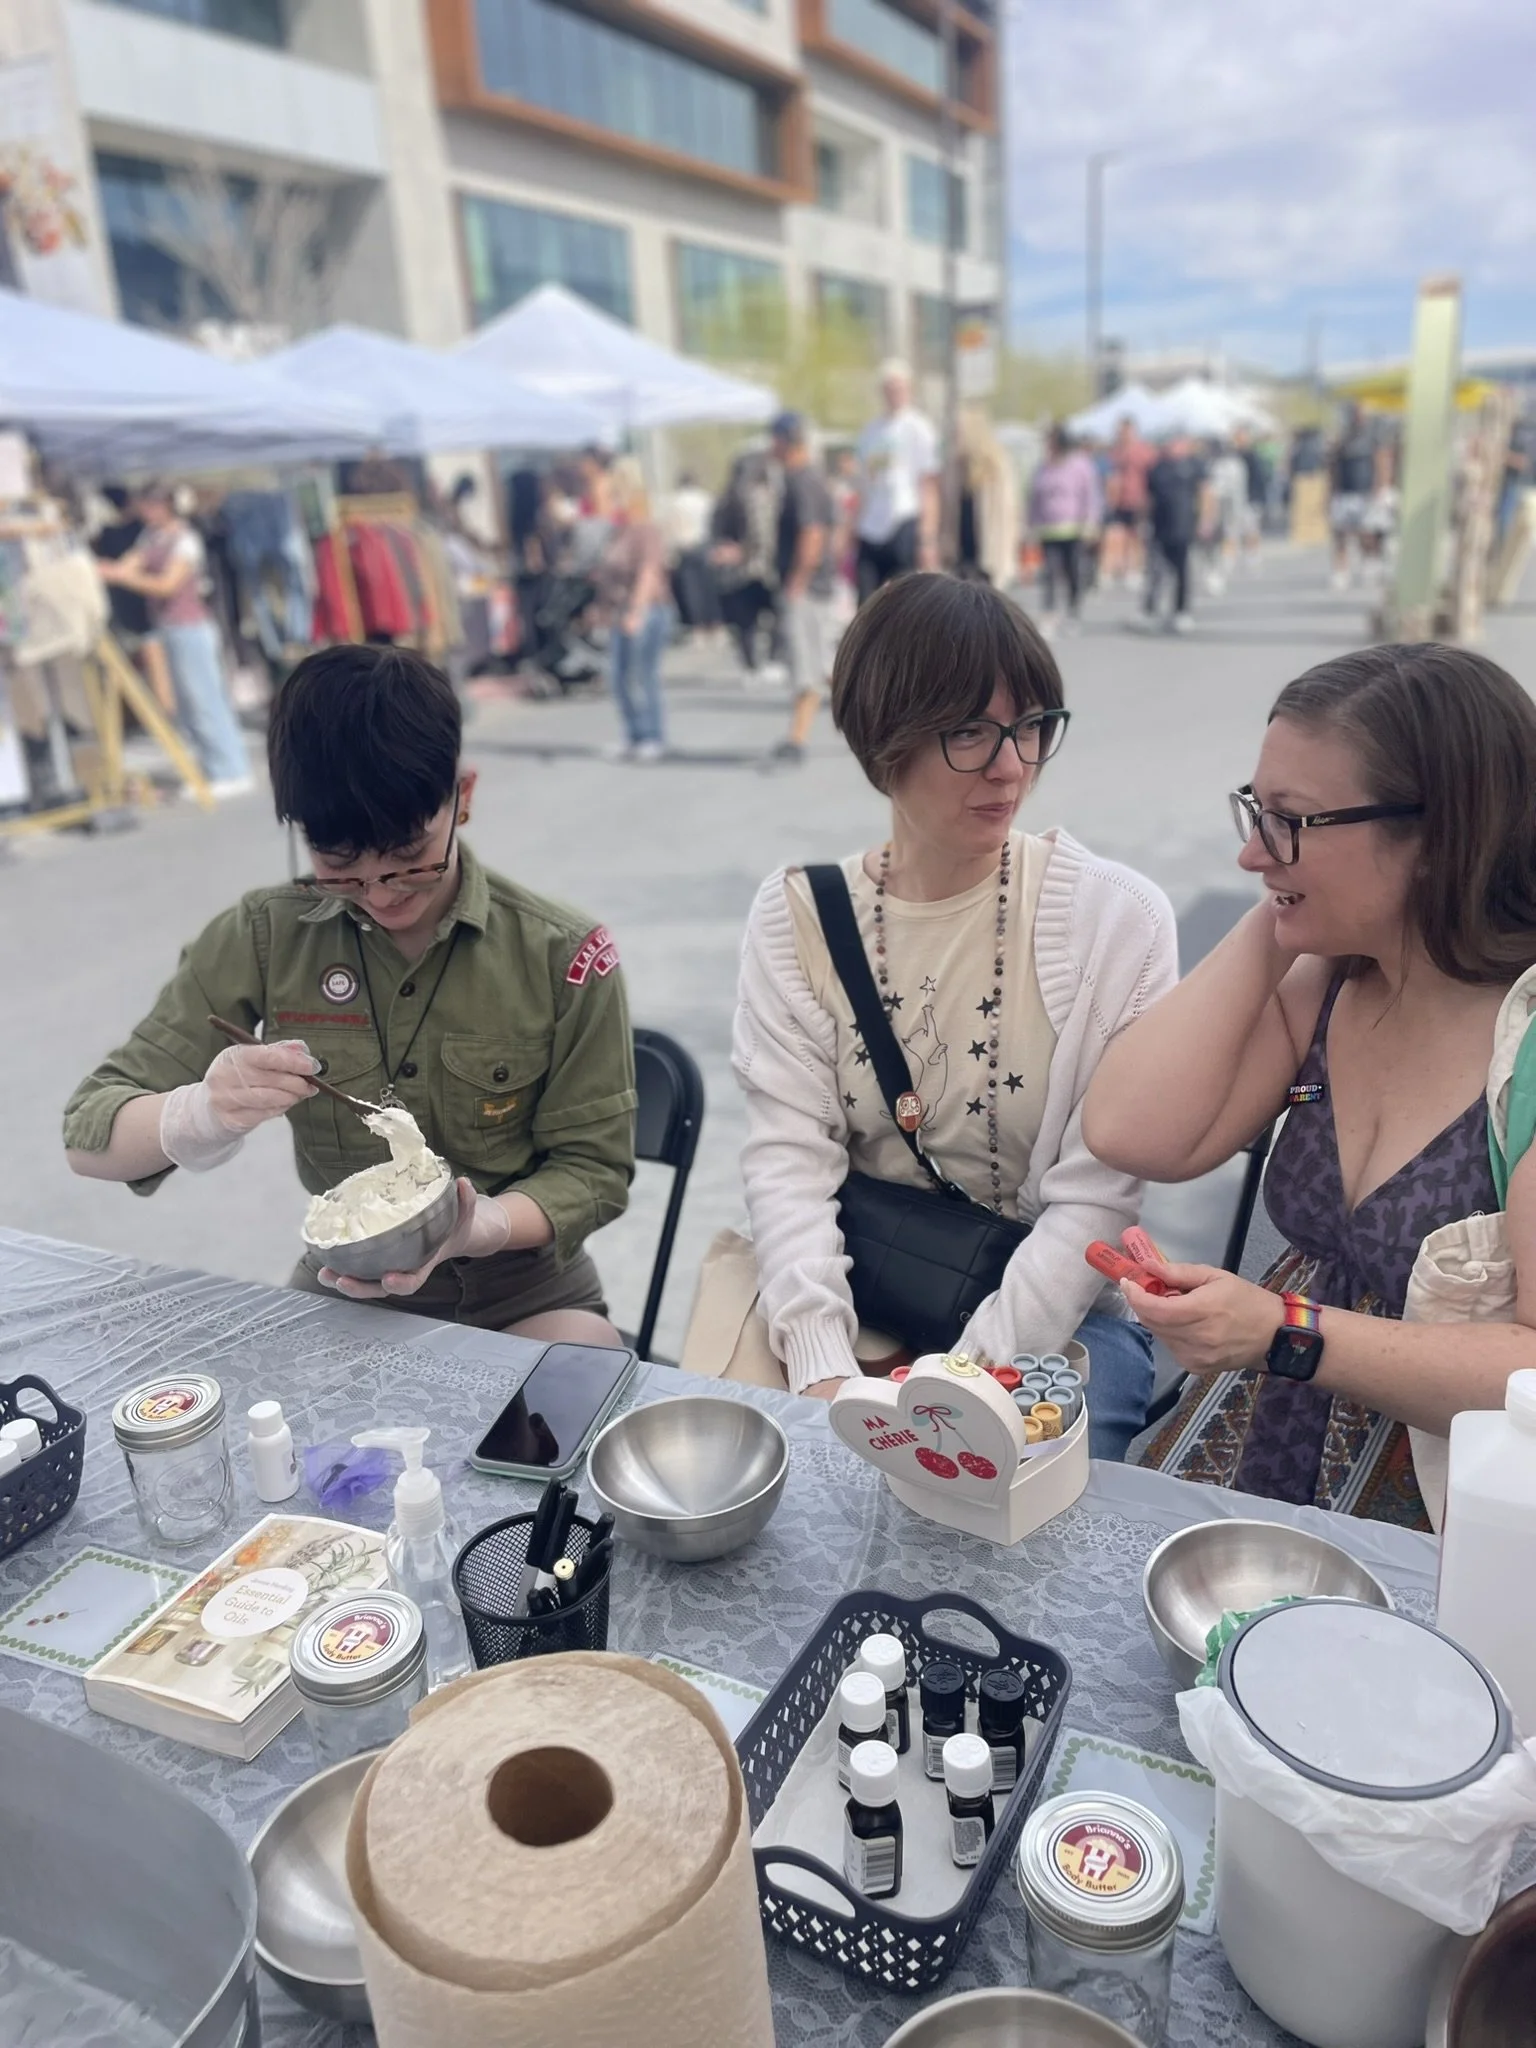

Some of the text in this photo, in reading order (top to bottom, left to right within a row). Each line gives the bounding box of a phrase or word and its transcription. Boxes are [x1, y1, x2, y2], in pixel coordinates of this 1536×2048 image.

[575, 943, 596, 969] LAS
[1290, 1084, 1318, 1093] PROUD
[1290, 1093, 1321, 1102] PARENT
[862, 1415, 890, 1431] MA
[869, 1429, 919, 1451] CHÉRIE
[235, 1584, 293, 1606] Essential
[224, 1596, 275, 1617] Guide to
[223, 1611, 249, 1625] Oils
[335, 1653, 363, 1661] Butter
[1085, 1825, 1131, 1850] Brianna's
[1062, 1863, 1118, 1892] Body Butter
